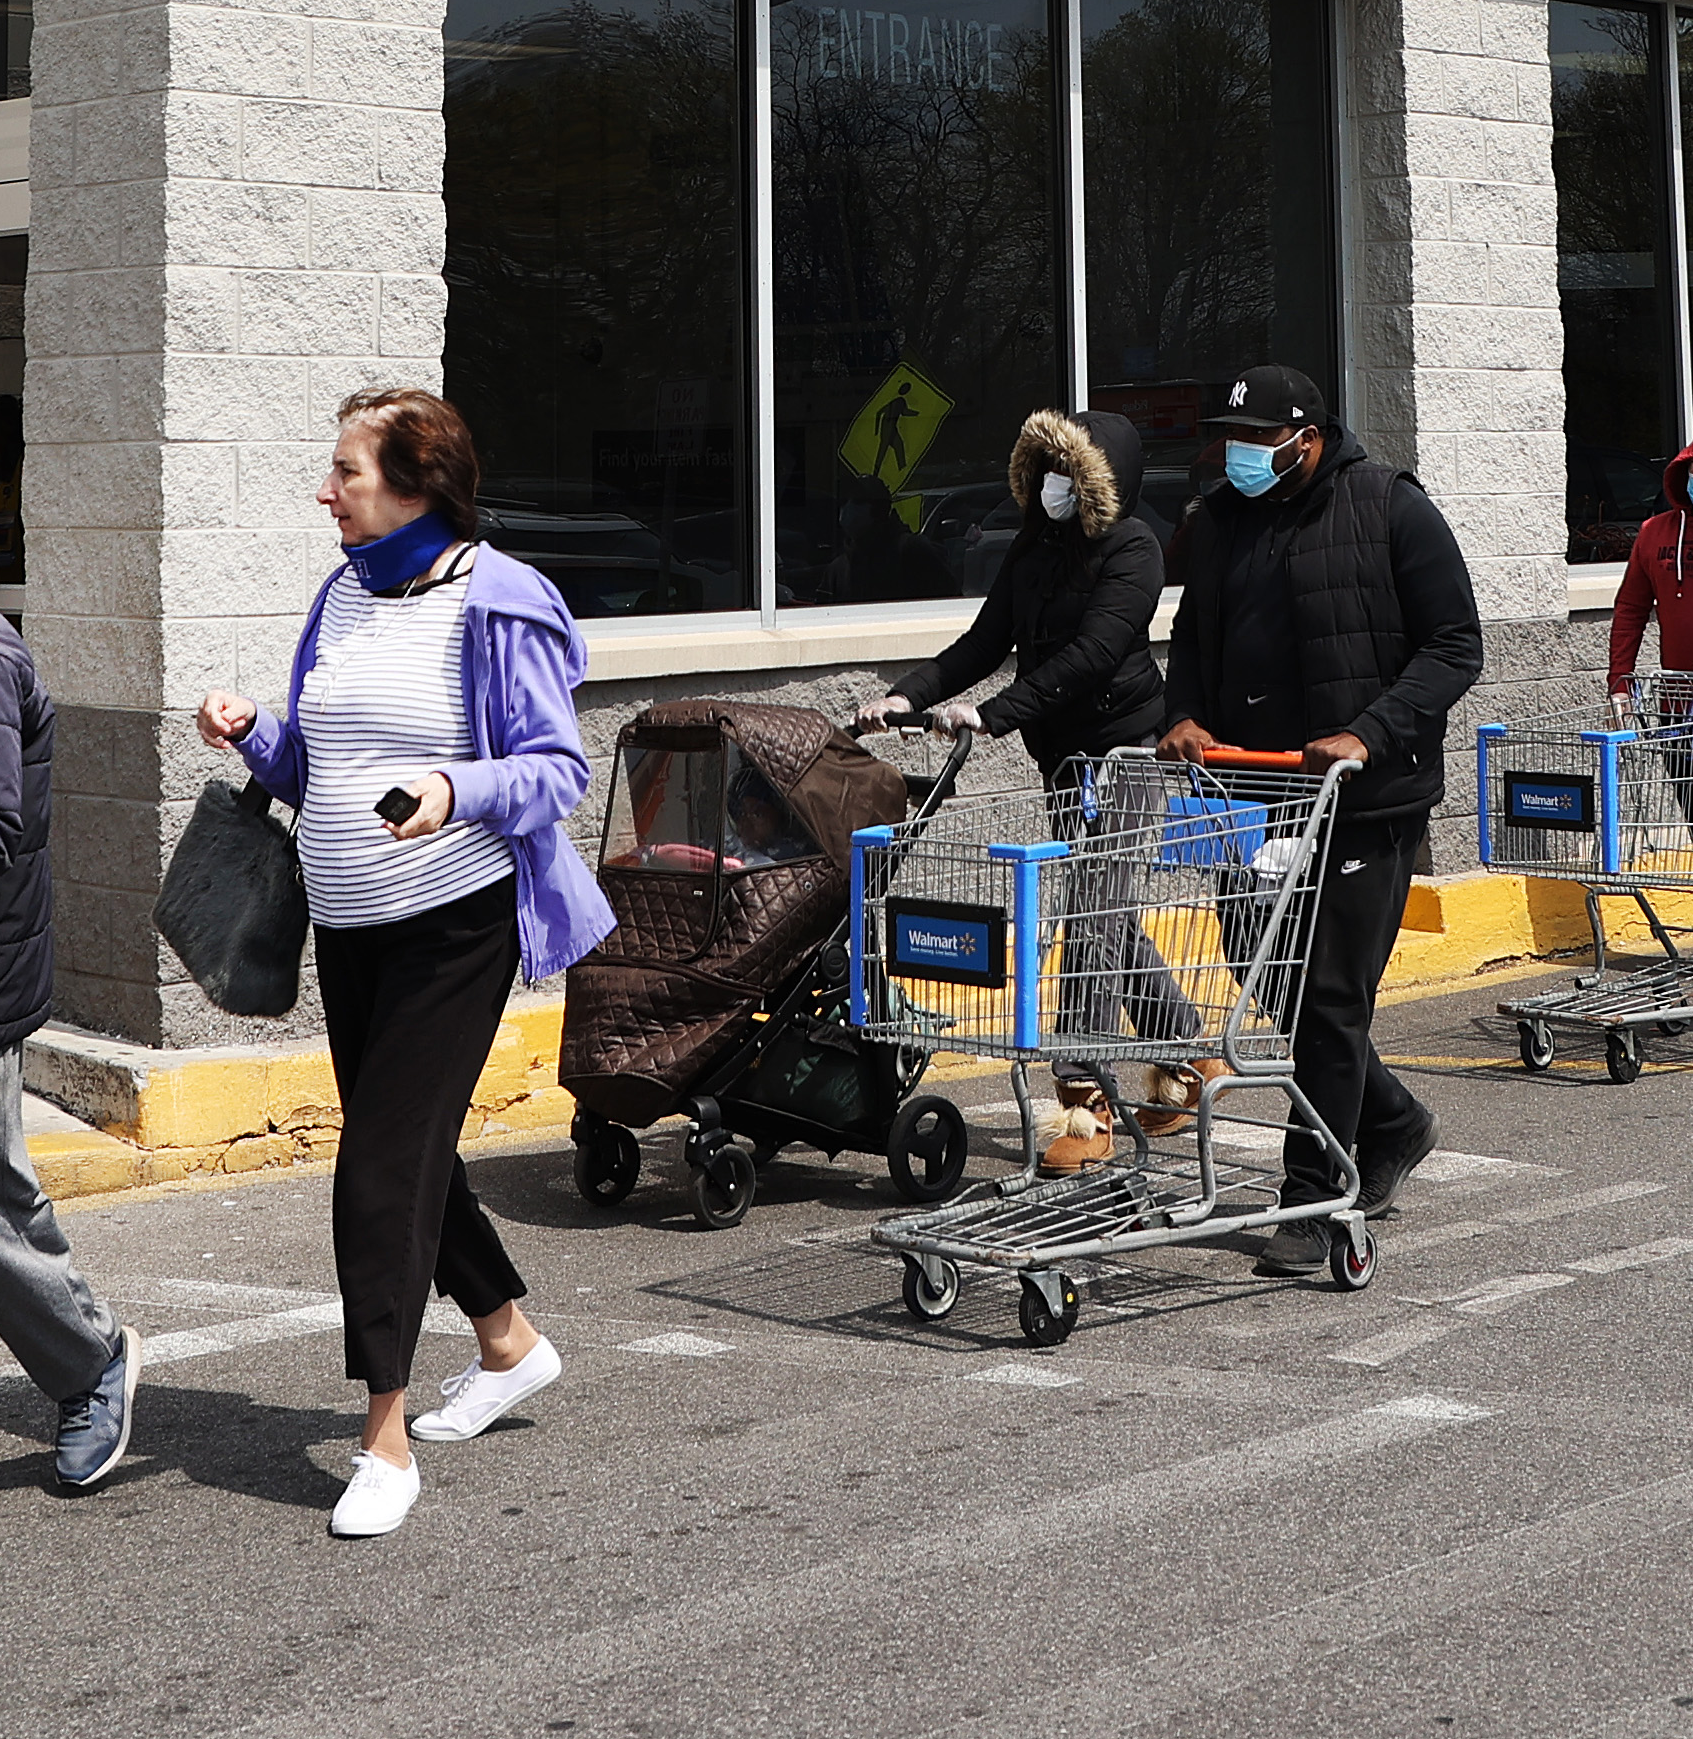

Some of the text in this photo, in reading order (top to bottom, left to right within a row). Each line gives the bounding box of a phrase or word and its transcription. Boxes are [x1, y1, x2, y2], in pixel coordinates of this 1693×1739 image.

[817, 6, 1005, 93] ENTRANCE
[599, 447, 630, 467] Find
[633, 453, 664, 473] your
[1521, 793, 1559, 807] Walmart
[908, 929, 958, 950] Walmart
